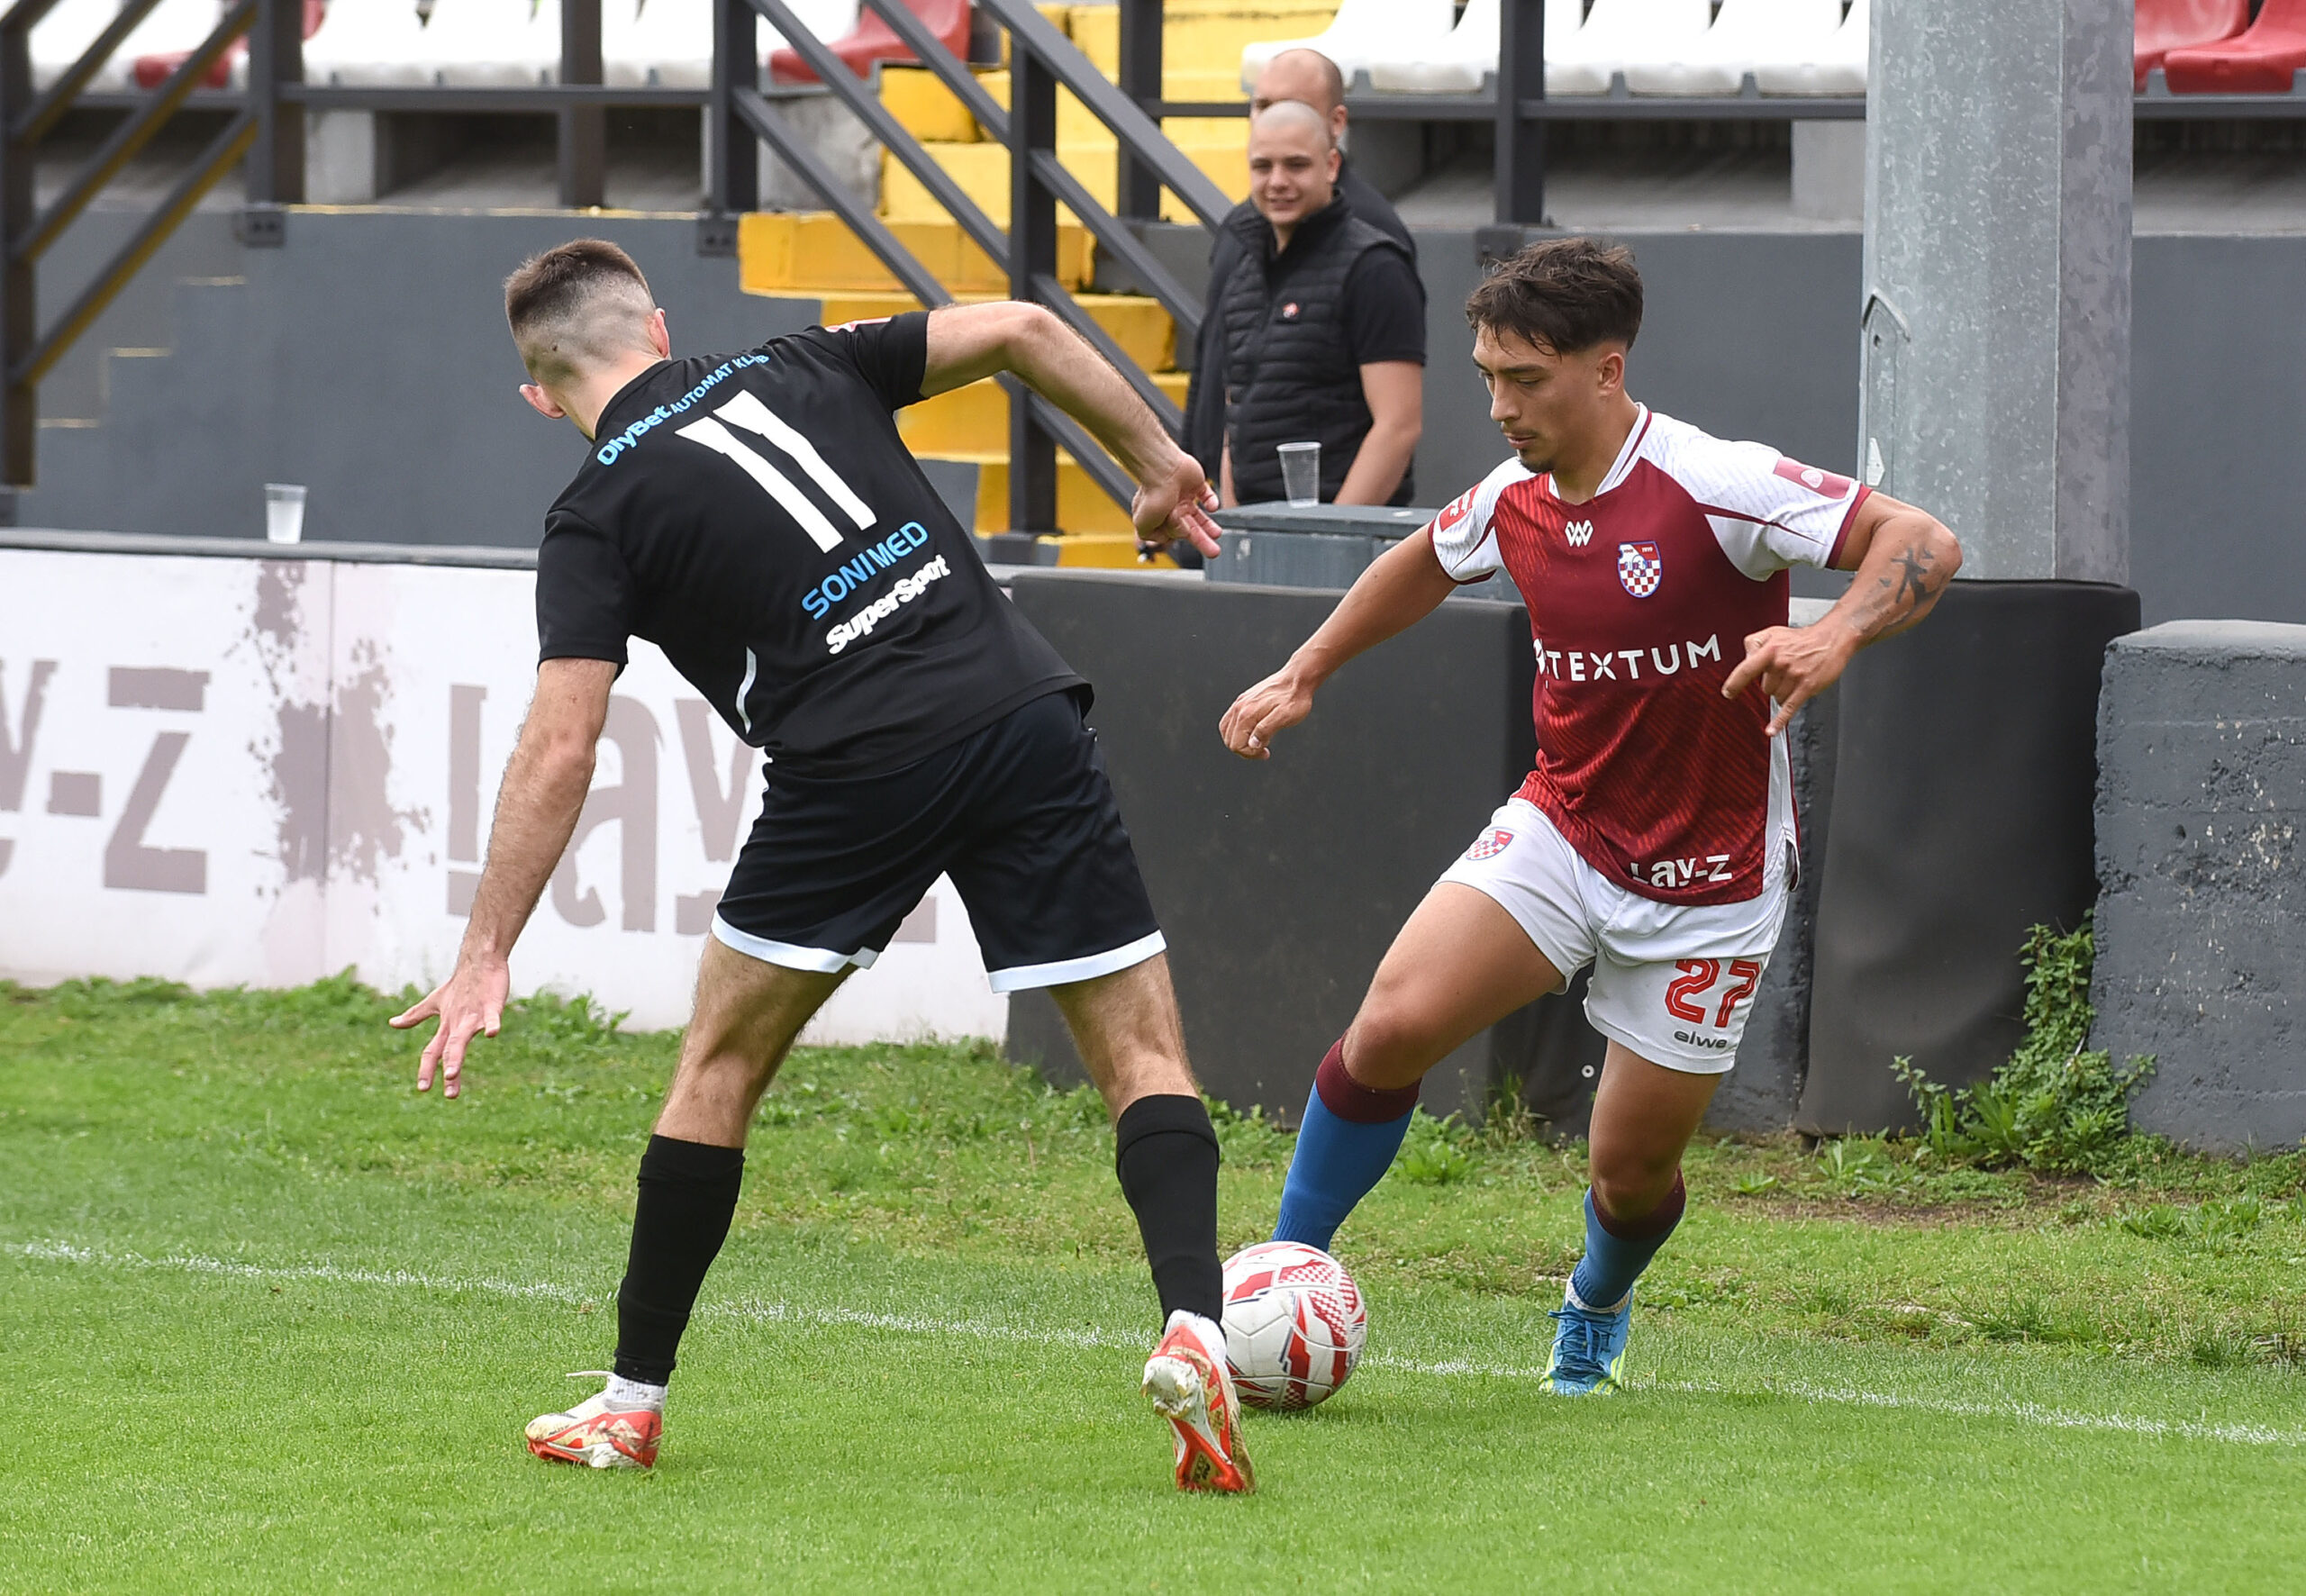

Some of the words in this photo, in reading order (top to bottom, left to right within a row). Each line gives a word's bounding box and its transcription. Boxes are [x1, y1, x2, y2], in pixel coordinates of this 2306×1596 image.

[597, 404, 672, 466] OlyBet
[669, 362, 733, 414] AUTOMAT
[731, 354, 770, 369] KLB
[674, 389, 877, 554] 11
[801, 521, 929, 621] SONIMED
[1630, 854, 1733, 888] Lay-Z
[1665, 957, 1761, 1029] 27
[1674, 1029, 1728, 1049] elwe
